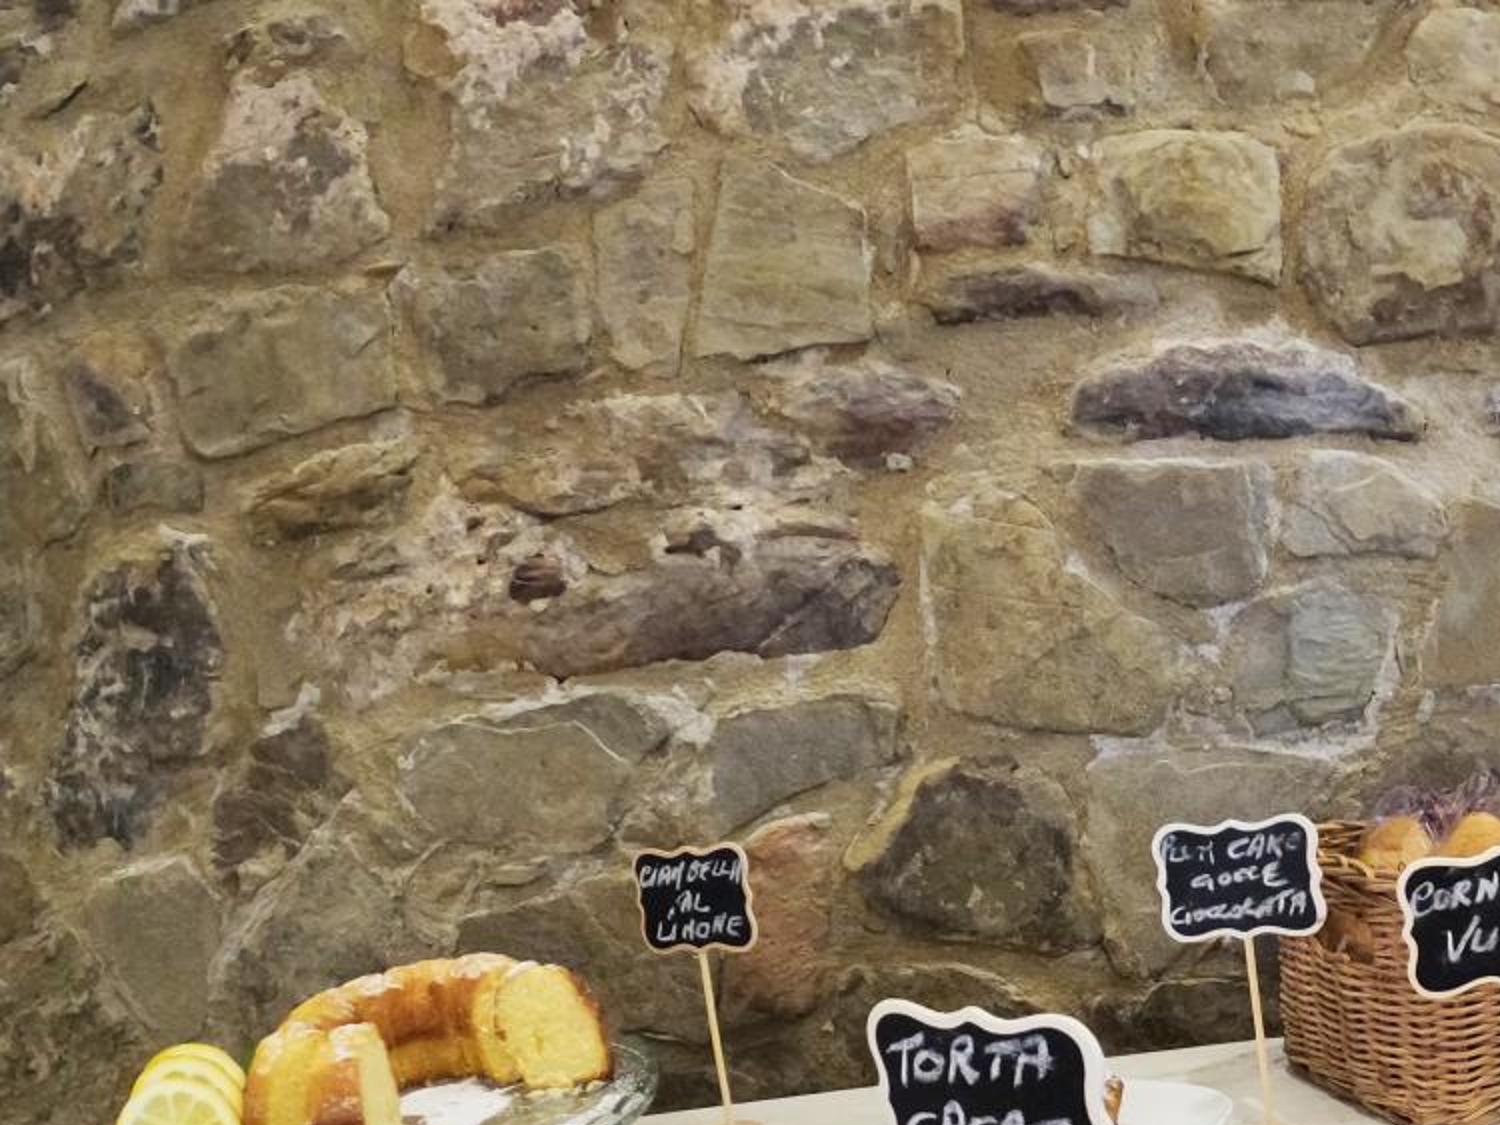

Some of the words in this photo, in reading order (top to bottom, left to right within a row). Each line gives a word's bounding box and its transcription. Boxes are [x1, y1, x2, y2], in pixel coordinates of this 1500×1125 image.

[1190, 861, 1289, 892] GOCCE
[675, 890, 711, 913] AL
[656, 910, 744, 941] LIMONE
[886, 1031, 1054, 1088] TORTA
